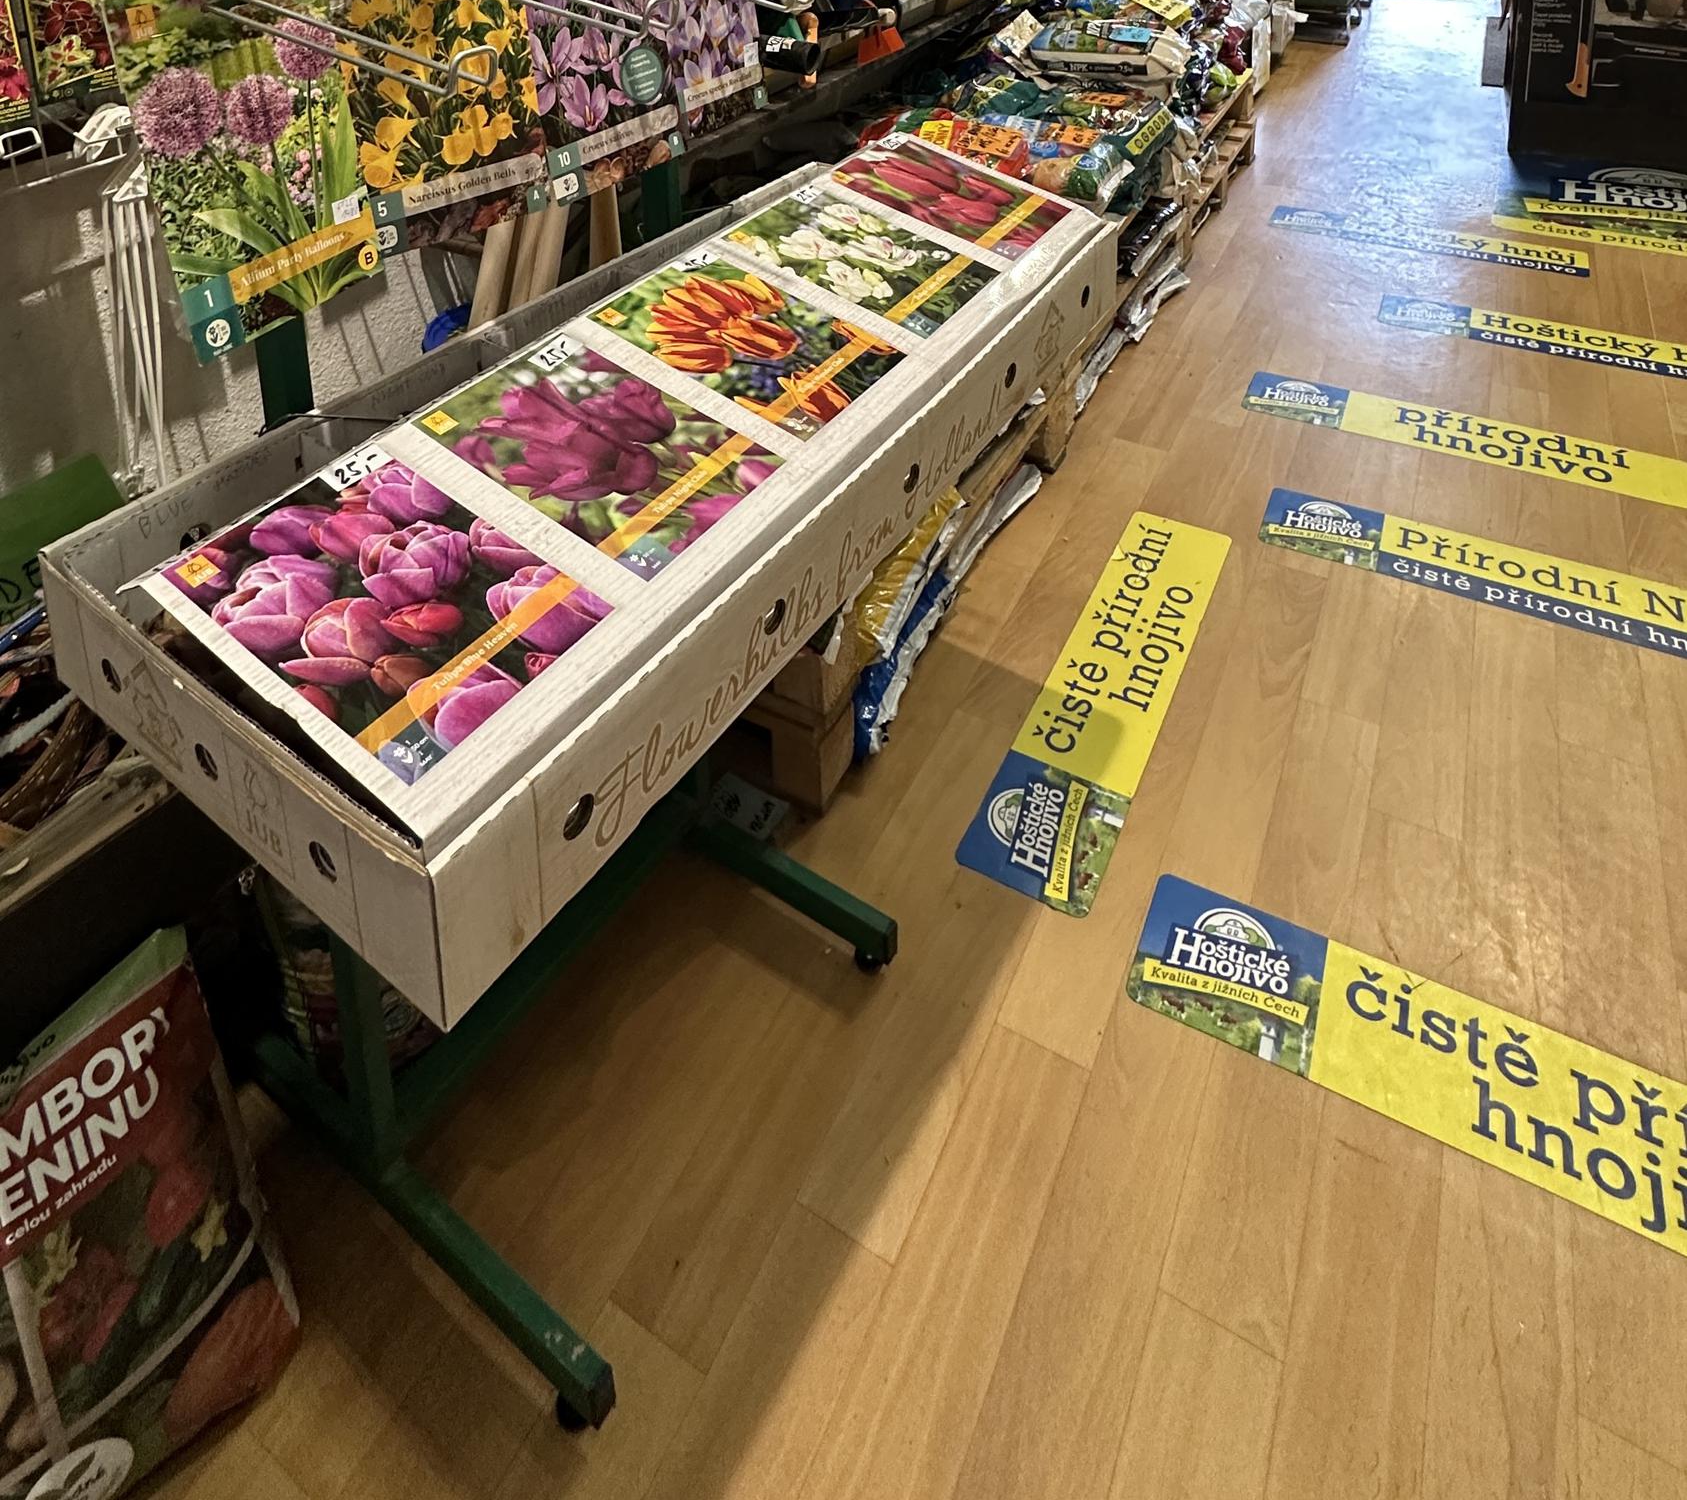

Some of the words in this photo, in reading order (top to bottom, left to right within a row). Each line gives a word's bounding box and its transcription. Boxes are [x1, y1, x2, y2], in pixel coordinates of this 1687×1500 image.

[557, 152, 571, 168] 10
[377, 200, 388, 218] 5
[408, 185, 457, 205] Narcissus
[458, 175, 492, 192] Golden
[493, 168, 517, 182] Bells
[533, 190, 540, 201] A
[1539, 202, 1619, 214] Kvalita
[1558, 179, 1687, 203] Hošti
[1500, 242, 1577, 266] hnůj
[1532, 223, 1592, 238] čistě
[239, 265, 276, 288] Allium
[304, 230, 346, 257] Balloons
[364, 251, 374, 265] B
[1496, 254, 1578, 274] hnojivo
[203, 289, 215, 308] 1
[1480, 330, 1541, 350] čistě
[1549, 342, 1659, 373] přírodní
[1481, 312, 1660, 358] Hoštický
[1397, 405, 1630, 470] přírodní
[1412, 422, 1613, 484] hnojivo
[334, 453, 379, 486] 25,-
[137, 498, 196, 539] BLUE
[1284, 509, 1362, 532] Hoštické
[1284, 517, 1362, 539] Hnojivo
[1396, 526, 1622, 607] Přírodní
[1392, 557, 1471, 591] čistě
[1485, 584, 1633, 637] přírodní
[432, 661, 465, 691] Tulipa
[483, 621, 518, 649] Heaven
[1031, 658, 1109, 754] čistě
[1091, 522, 1173, 658] přírodní
[1107, 585, 1195, 714] hnojivo
[594, 568, 832, 849] Flowerbulbs
[836, 518, 896, 604] from
[246, 808, 283, 858] JUB
[1010, 782, 1050, 873] Hoštické
[1024, 787, 1065, 878] Hnojivo
[1051, 852, 1068, 895] Kvalita
[1061, 812, 1077, 842] jižních
[1069, 786, 1085, 812] Čech
[1166, 927, 1291, 978] Hoštické
[1166, 946, 1290, 996] Hnojivo
[1150, 965, 1198, 989] Kvalita
[1201, 978, 1210, 990] z
[1209, 980, 1260, 1005] jižních
[1262, 993, 1301, 1019] Čech
[1345, 965, 1539, 1088] čistě
[0, 1065, 160, 1228] ENINU
[5, 1207, 51, 1246] celou
[55, 1153, 118, 1210] zahradu
